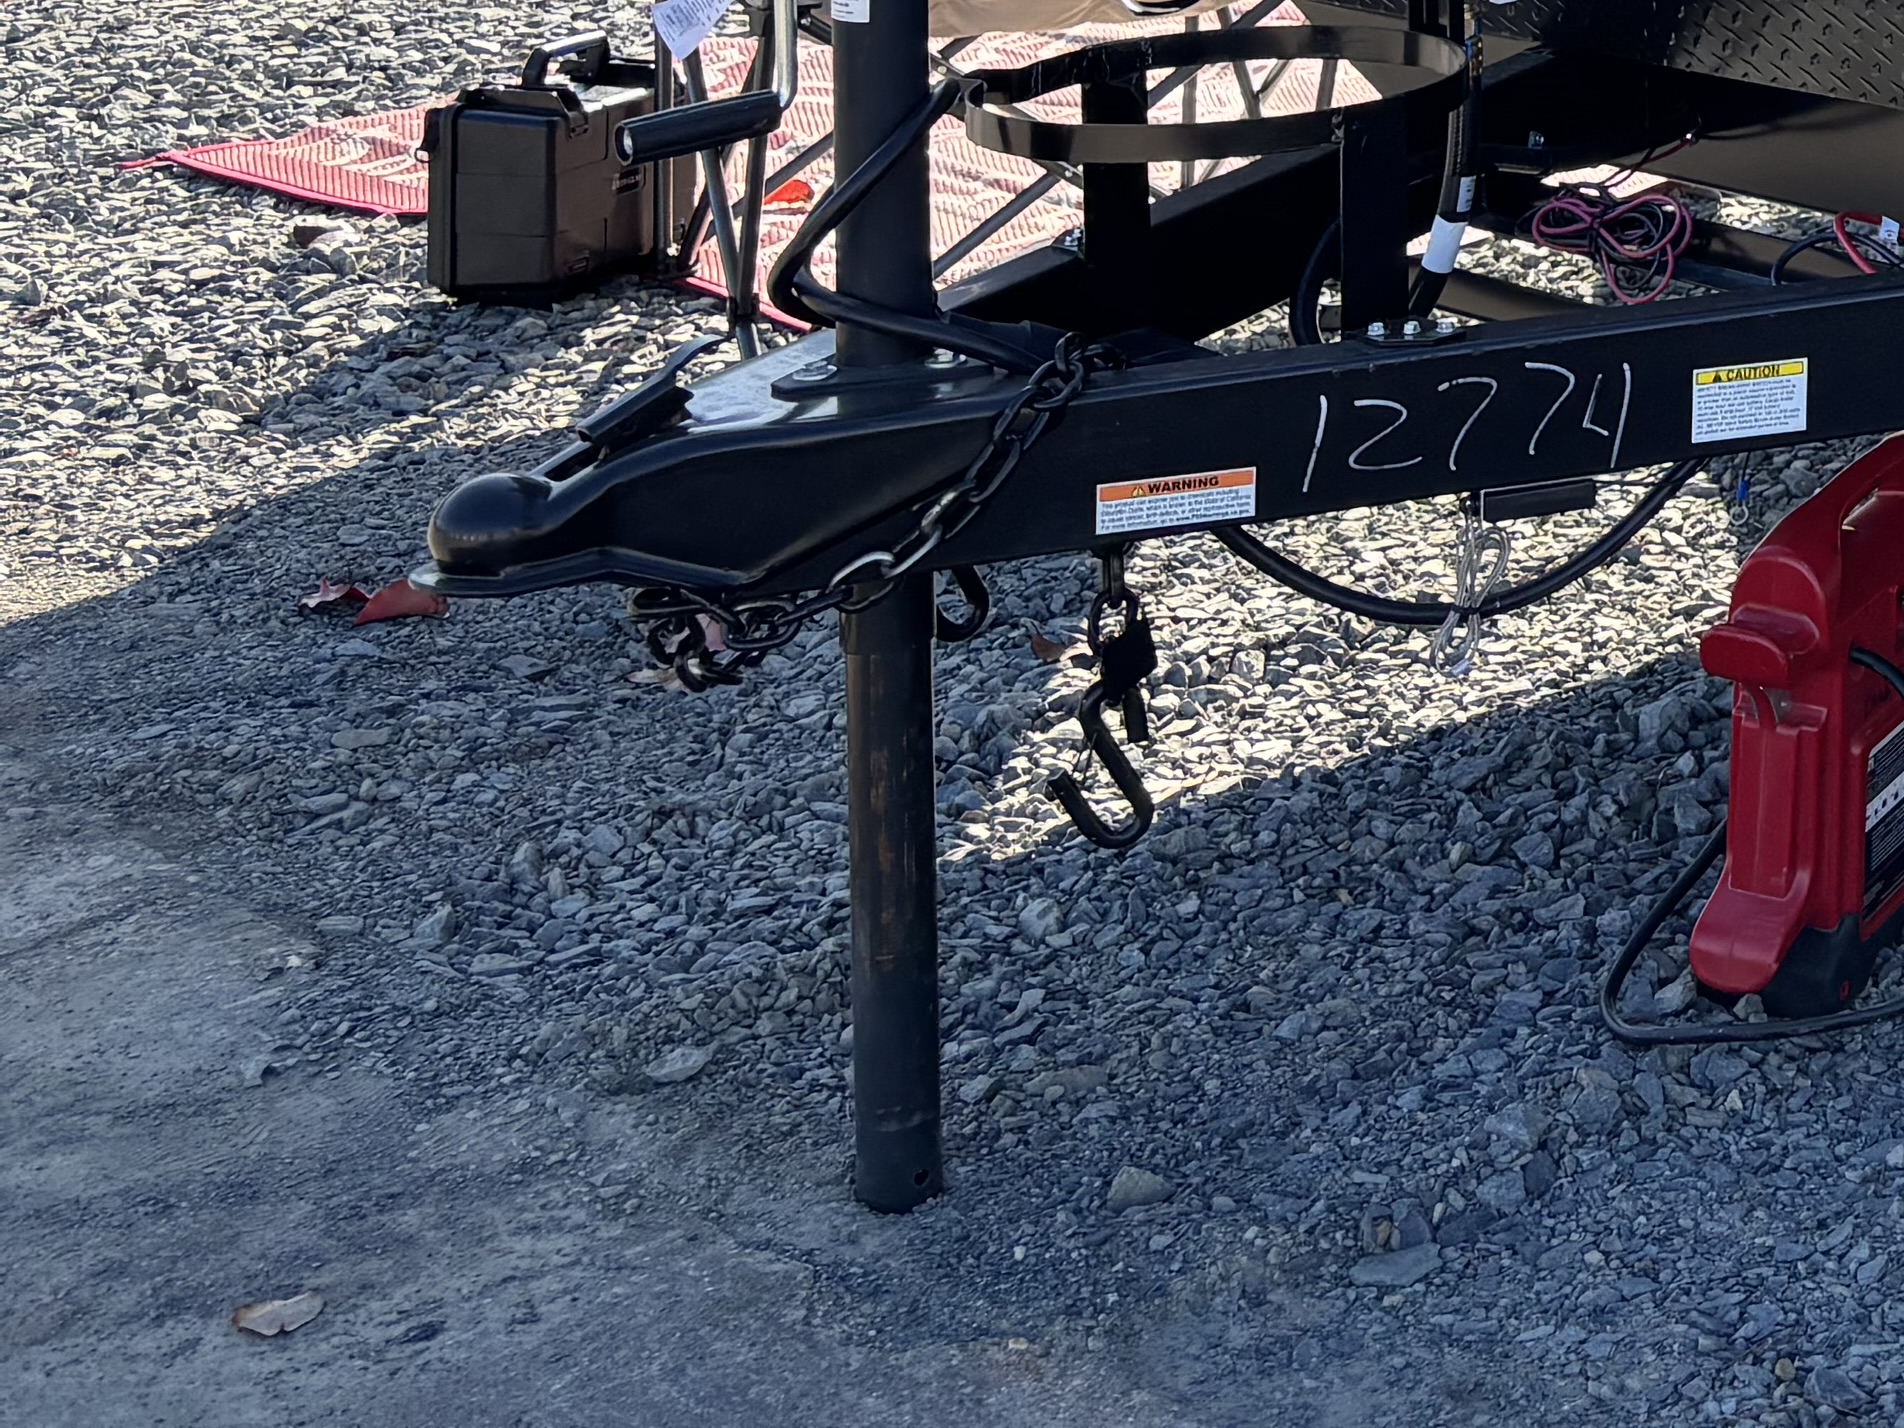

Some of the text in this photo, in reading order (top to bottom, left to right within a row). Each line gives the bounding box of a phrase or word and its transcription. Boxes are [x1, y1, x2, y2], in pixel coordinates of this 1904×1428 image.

[1726, 364, 1781, 383] CAUTION
[1302, 359, 1632, 494] 12774
[1148, 476, 1219, 494] WARNING
